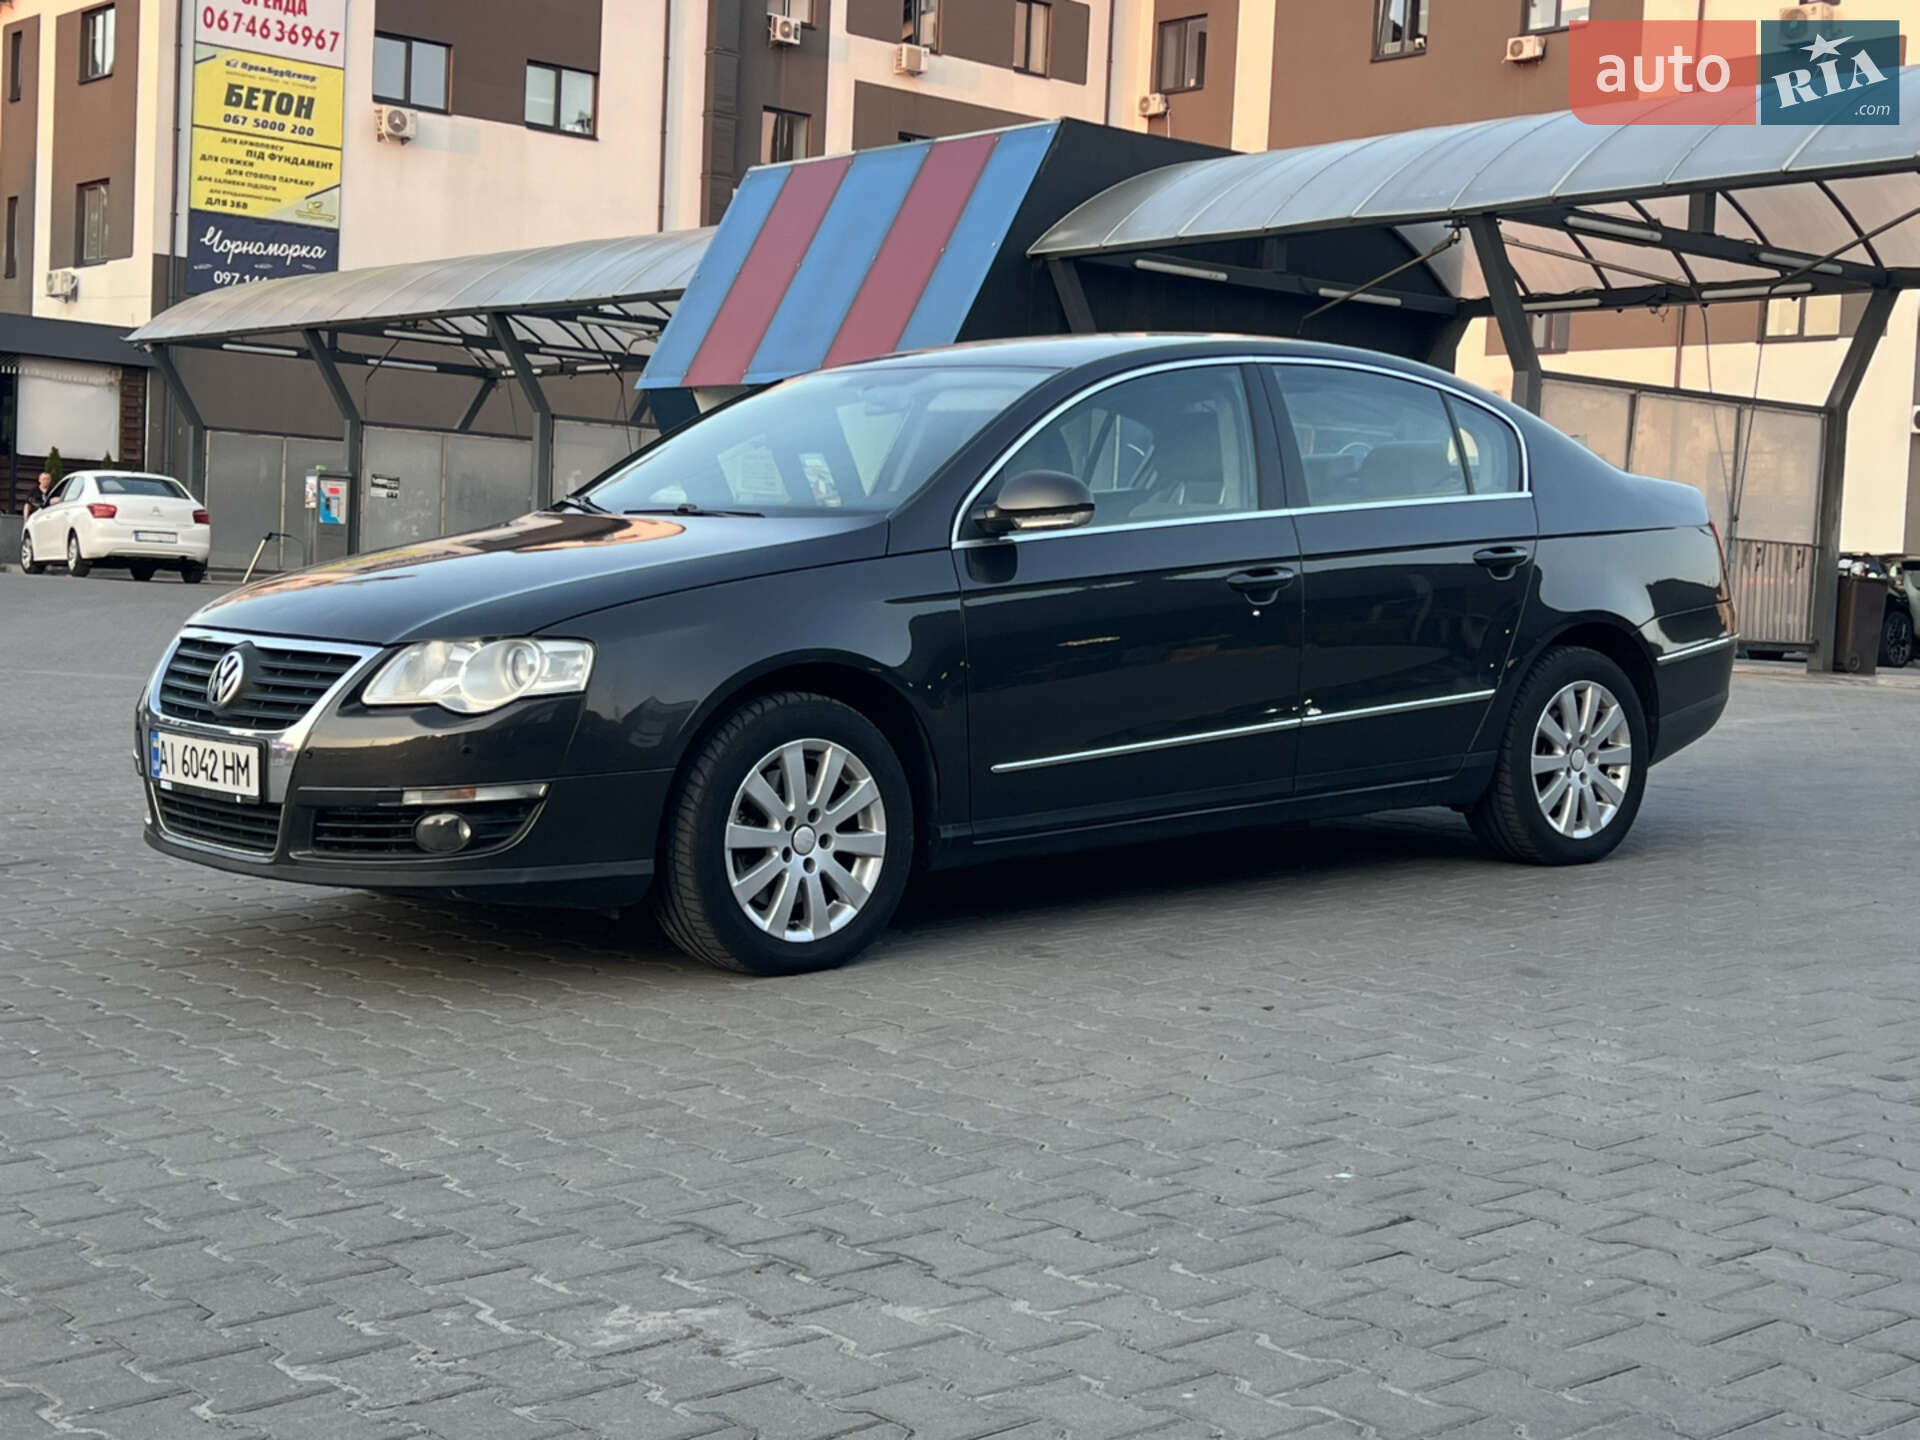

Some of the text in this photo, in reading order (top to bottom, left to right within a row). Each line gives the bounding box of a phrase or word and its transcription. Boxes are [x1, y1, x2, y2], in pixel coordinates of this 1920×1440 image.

[224, 83, 315, 120] БЕТОН
[223, 113, 315, 137] 067 5000 200
[221, 136, 238, 144] ДЛЯ
[200, 153, 219, 163] ДЛЯ
[246, 149, 334, 170] ПІД ФУНДАМЕНТ
[197, 175, 213, 183] ДЛЯ
[225, 168, 244, 177] ДЛЯ
[205, 196, 228, 207] ДЛЯ
[200, 226, 327, 266] Чорноморка
[213, 271, 240, 285] 097
[160, 740, 251, 788] AI 6042 HM
